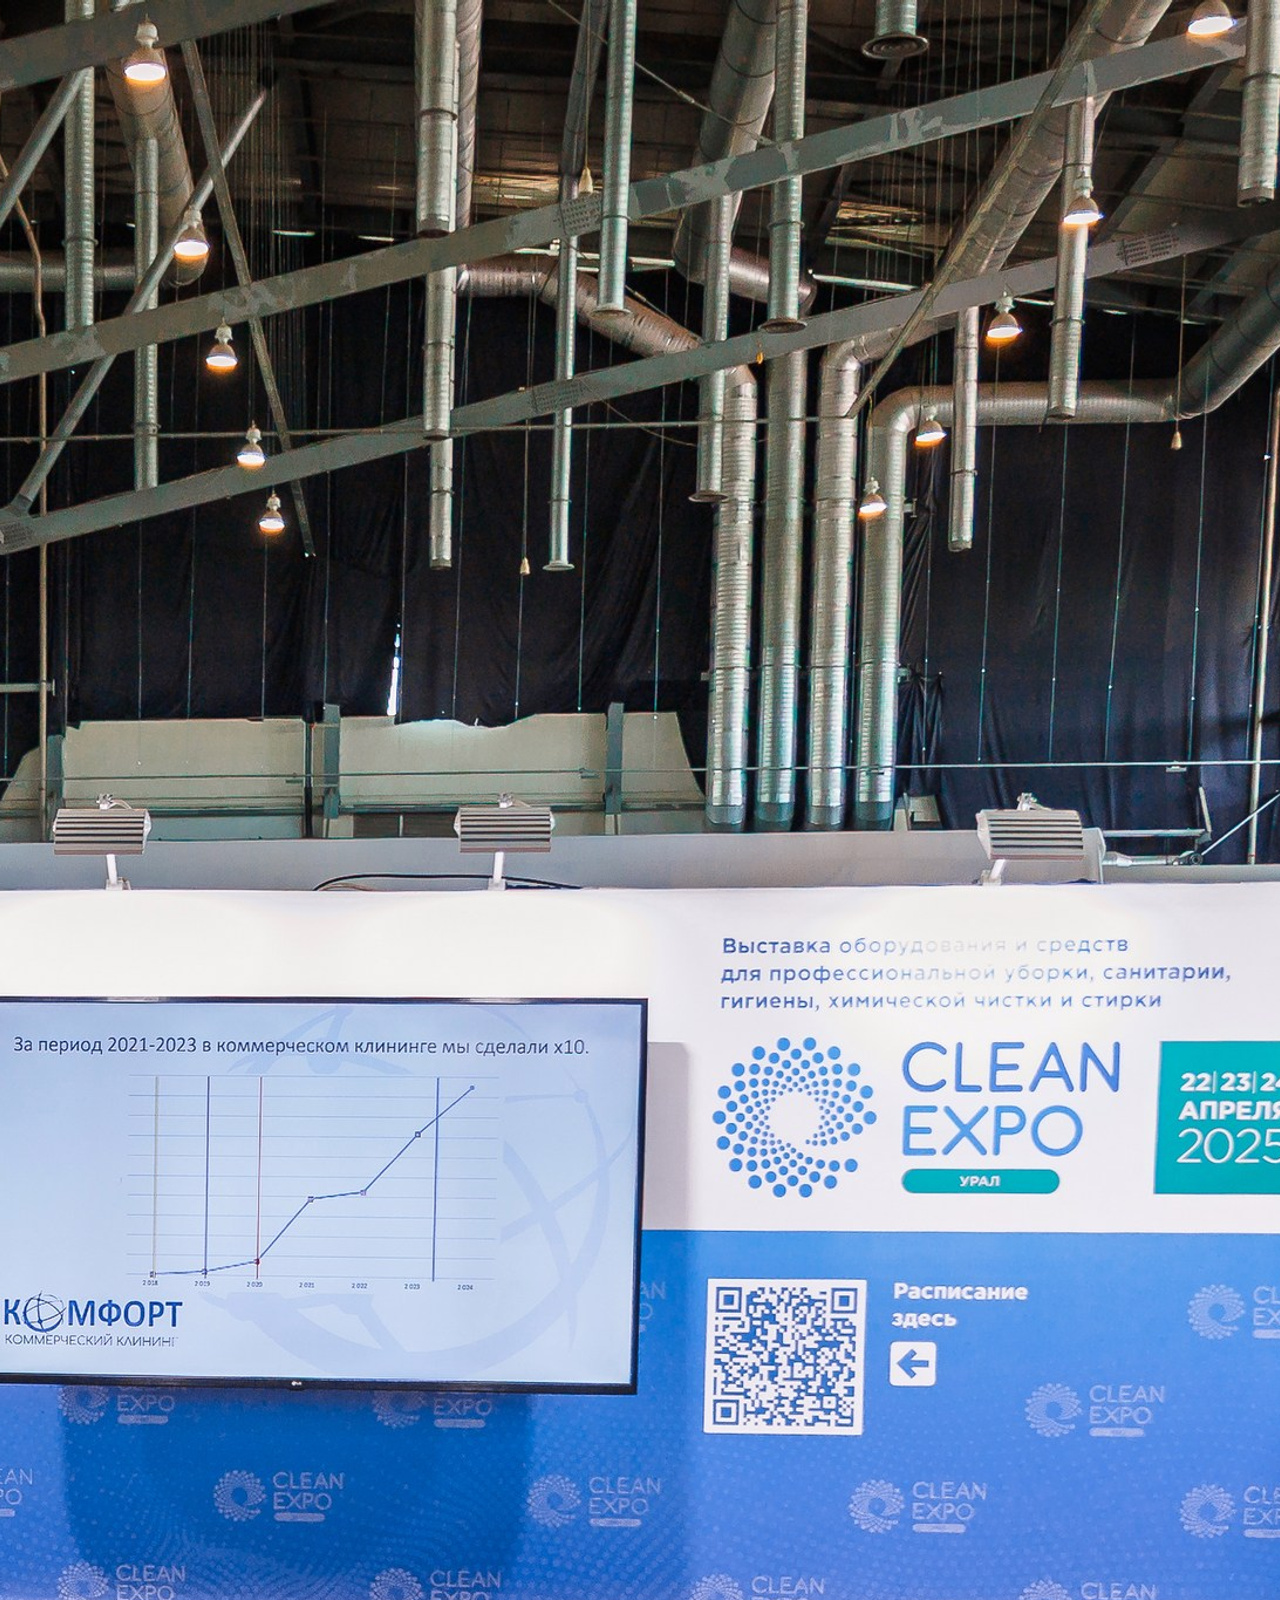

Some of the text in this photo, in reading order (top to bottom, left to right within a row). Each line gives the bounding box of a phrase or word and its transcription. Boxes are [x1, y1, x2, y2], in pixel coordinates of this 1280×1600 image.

[723, 937, 1129, 956] Выставка оборудования и средств
[721, 965, 1232, 984] для профессиональной уборки, санитарии,
[721, 992, 1162, 1012] гигиены, химической чистки и стирки
[13, 1036, 32, 1051] За
[38, 1039, 103, 1055] период
[108, 1037, 196, 1053] 2021-2023
[202, 1041, 211, 1052] в
[217, 1040, 350, 1057] коммерческом
[354, 1042, 437, 1054] клининге
[442, 1043, 470, 1055] мы
[475, 1042, 548, 1057] сделали
[902, 1041, 1120, 1093] CLEAN
[902, 1104, 1083, 1157] EXPO
[1176, 1127, 1280, 1164] 2025
[959, 1175, 1001, 1187] УРАЛ
[893, 1282, 1029, 1301] Расписание
[891, 1312, 958, 1329] здесь
[5, 1333, 113, 1346] КОММЕРЧЕСКИЙ
[1089, 1384, 1165, 1403] CLEAN
[117, 1395, 175, 1413] EXPO
[434, 1399, 492, 1417] EXPO
[1089, 1406, 1152, 1425] EXPO
[272, 1471, 344, 1490] CLEAN
[589, 1476, 661, 1495] CLEAN
[912, 1482, 988, 1501] CLEAN
[272, 1493, 333, 1511] EXPO
[589, 1497, 649, 1516] EXPO
[913, 1502, 974, 1521] EXPO
[115, 1564, 186, 1583] CLEAN
[429, 1570, 501, 1589] CLEAN
[751, 1576, 825, 1596] CLEAN
[1080, 1582, 1157, 1600] CLEAN
